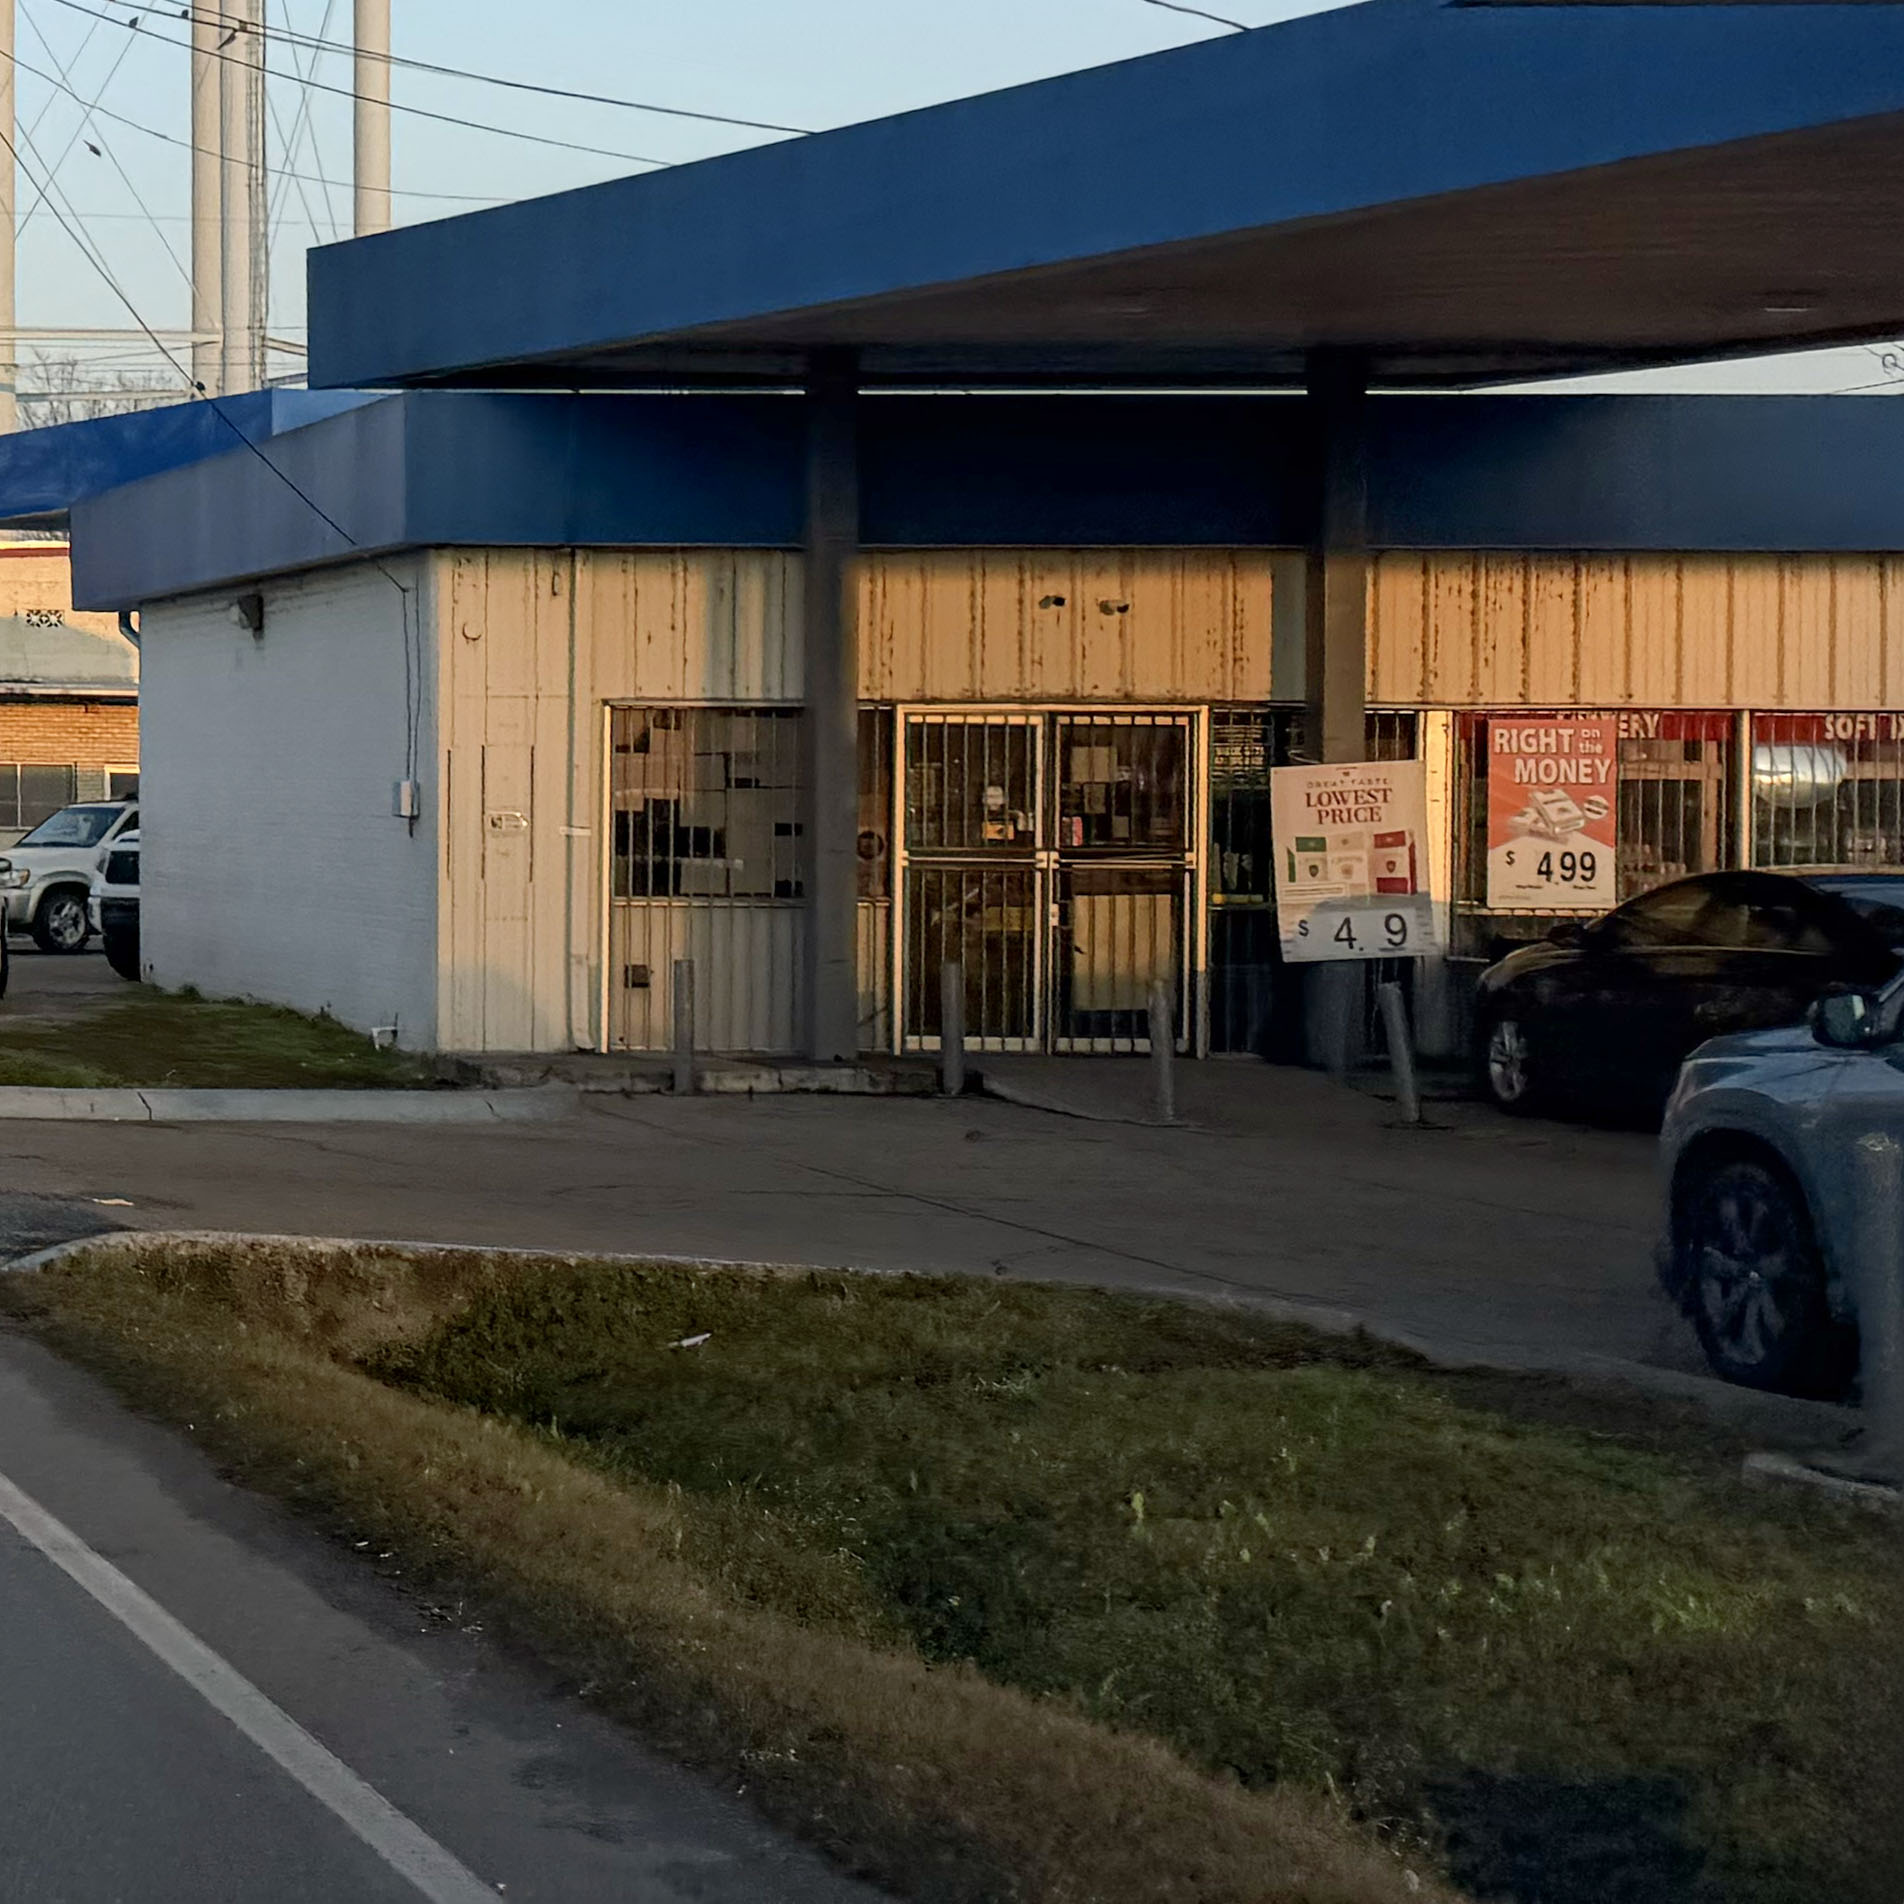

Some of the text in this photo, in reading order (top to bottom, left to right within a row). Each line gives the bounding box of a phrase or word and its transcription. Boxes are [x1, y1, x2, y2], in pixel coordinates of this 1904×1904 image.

[1825, 712, 1876, 740] SOFT
[1494, 728, 1601, 754] RIGHT on
[1579, 741, 1603, 754] the
[1514, 758, 1612, 784] MONEY
[1305, 788, 1393, 808] LOWEST
[1318, 806, 1382, 825] PRICE
